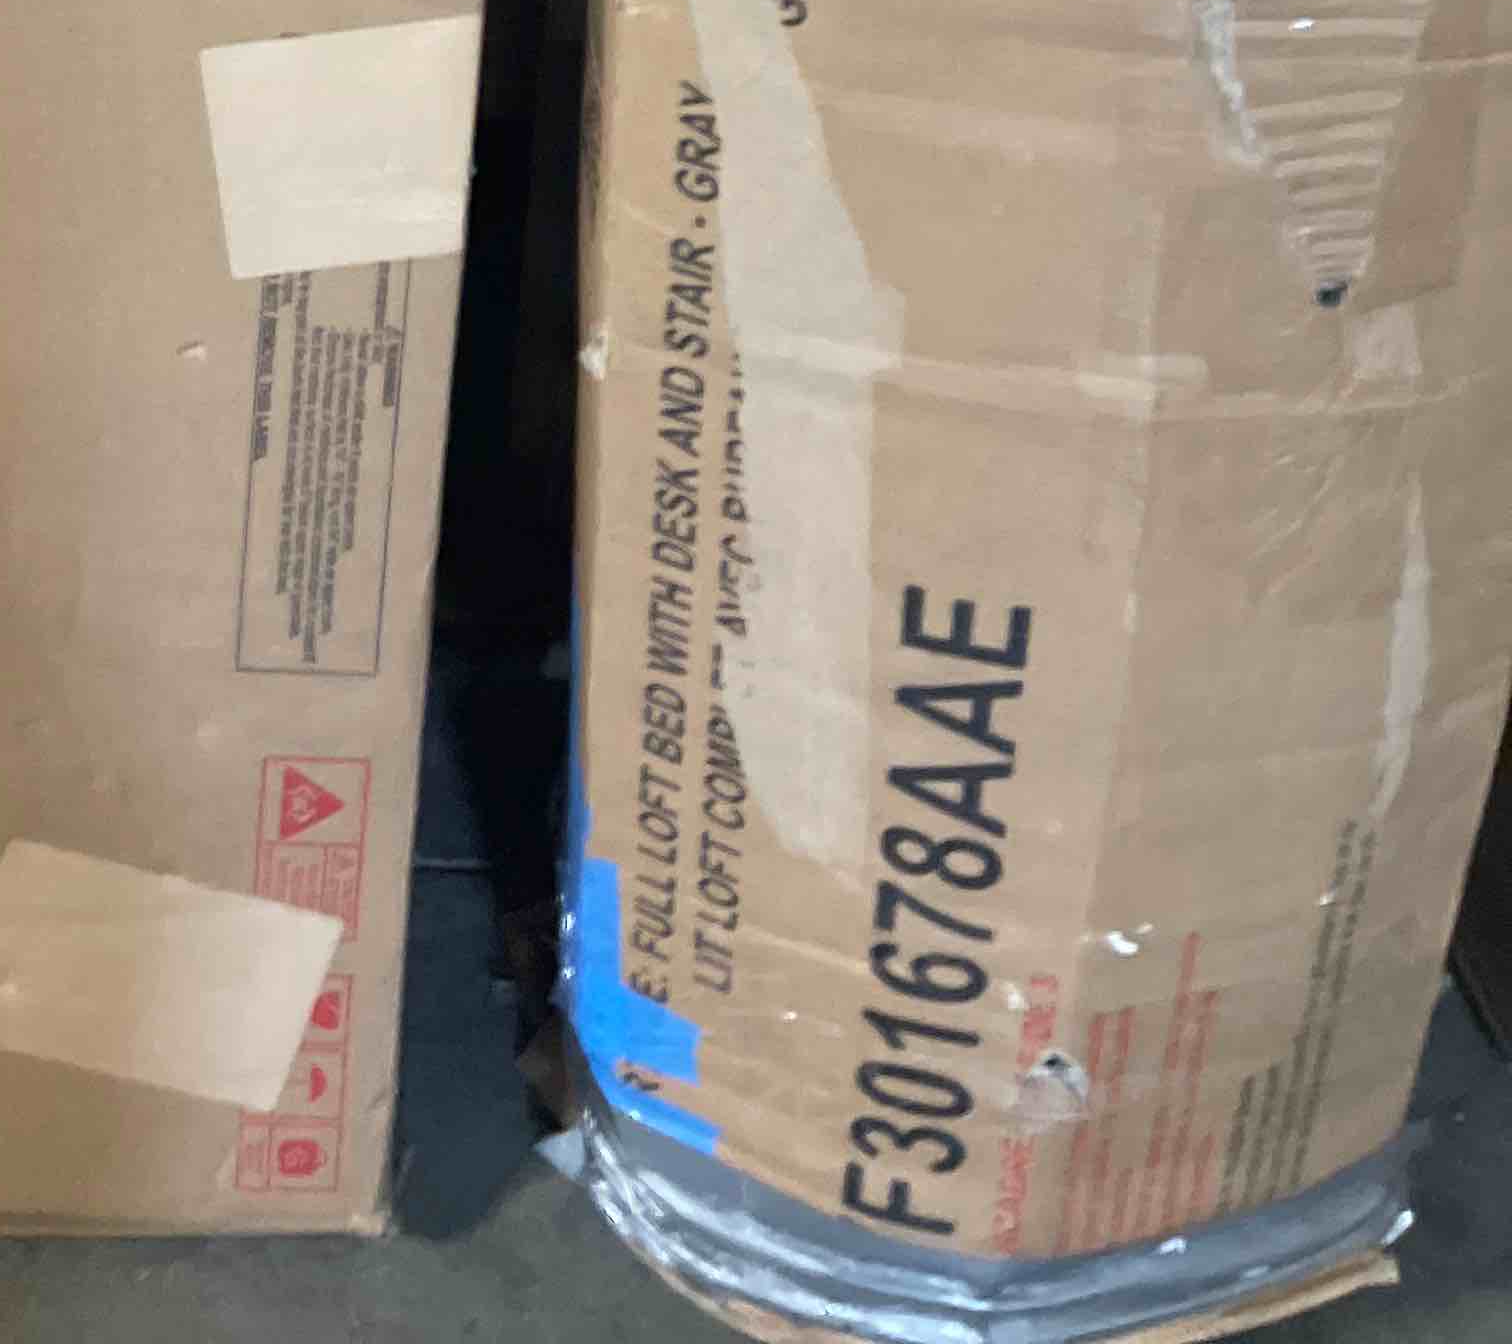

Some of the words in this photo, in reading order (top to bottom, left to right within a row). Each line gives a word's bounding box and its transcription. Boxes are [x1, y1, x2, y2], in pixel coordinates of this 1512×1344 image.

[673, 80, 722, 202] GRAY
[663, 238, 716, 358] STAIR
[657, 366, 705, 458] AND
[650, 459, 700, 572] DESK
[646, 576, 693, 676] WITH
[642, 683, 687, 766] BED
[636, 764, 682, 866] LOFT
[630, 874, 677, 963] FULL
[697, 830, 743, 932] LOFT
[841, 585, 1033, 1236] F301678AAE
[693, 930, 734, 996] LIT
